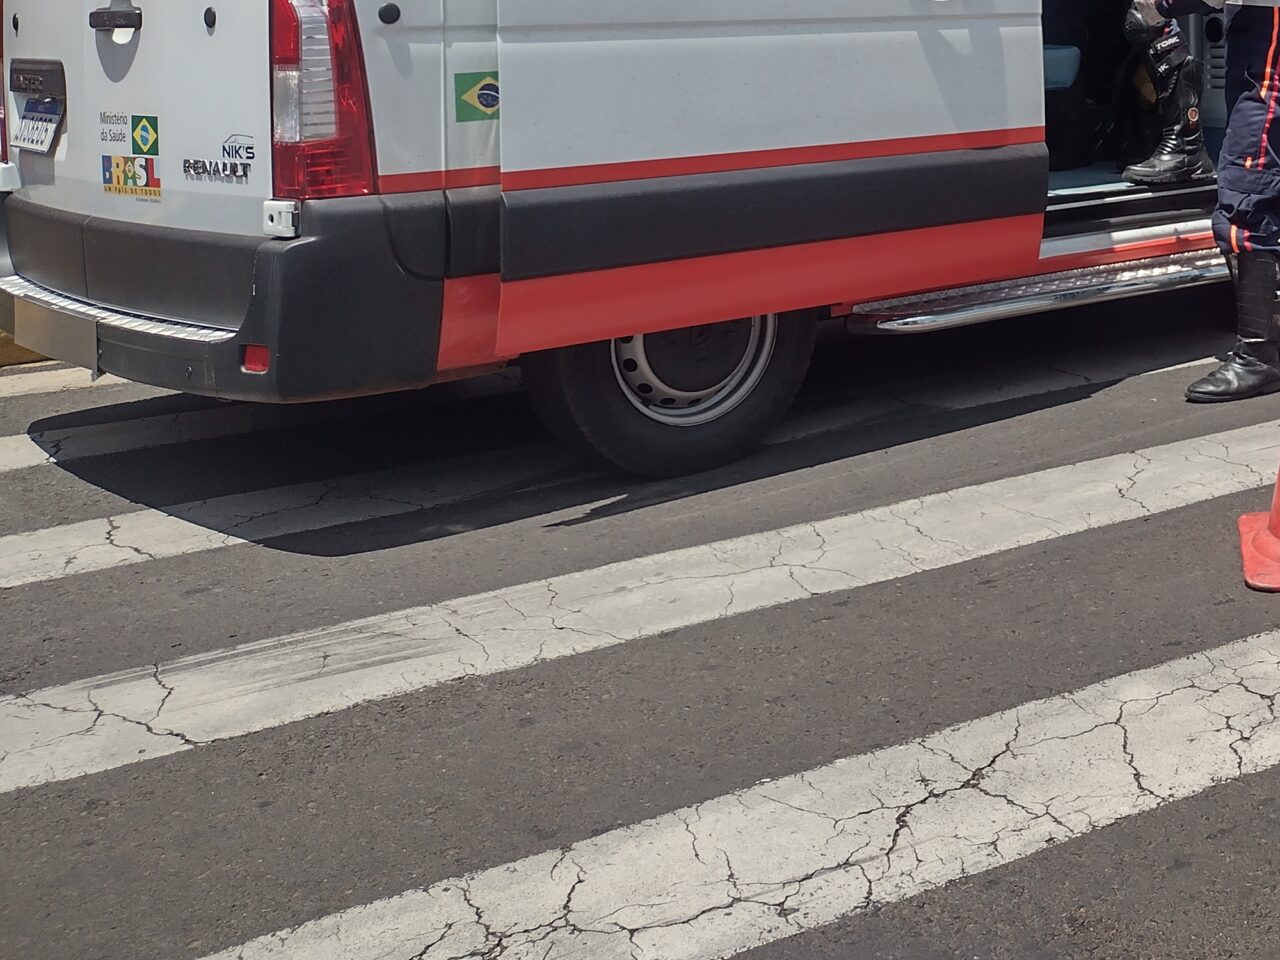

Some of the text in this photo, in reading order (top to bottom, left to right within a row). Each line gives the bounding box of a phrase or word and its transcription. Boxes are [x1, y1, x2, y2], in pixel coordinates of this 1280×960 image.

[99, 112, 128, 126] Ministério
[100, 129, 127, 143] da Saúde
[222, 144, 255, 160] NIK'S
[183, 158, 252, 179] RENAULT
